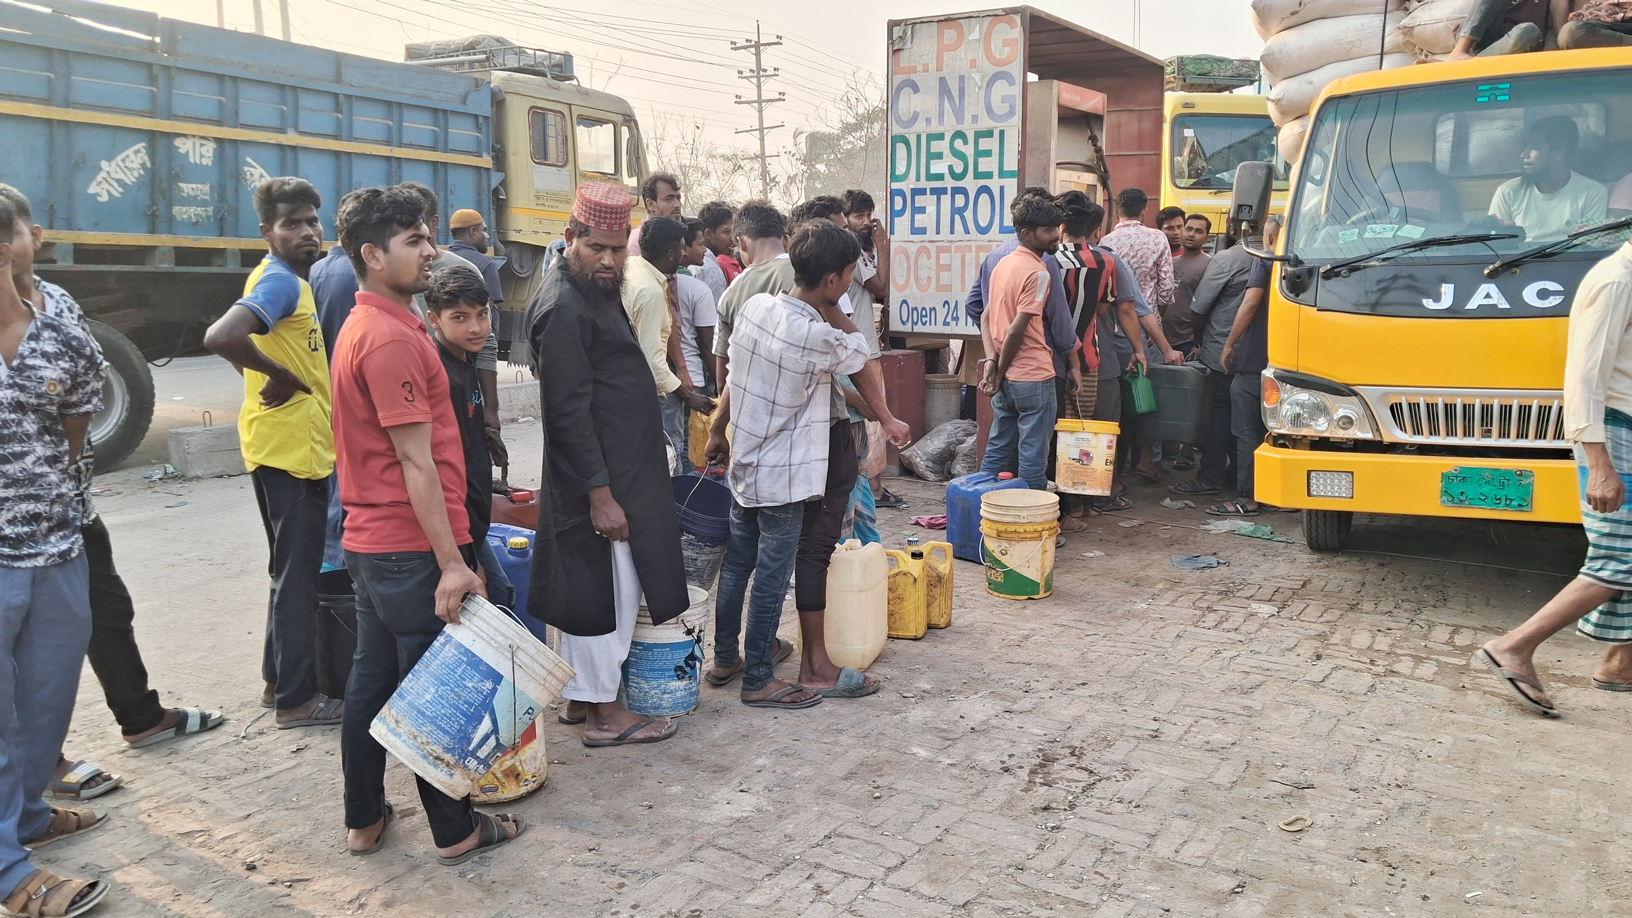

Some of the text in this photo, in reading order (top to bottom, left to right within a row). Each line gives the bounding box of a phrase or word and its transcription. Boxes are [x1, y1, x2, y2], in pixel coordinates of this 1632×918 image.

[891, 70, 1017, 129] C.N.G
[891, 129, 1018, 183] DIESEL
[890, 185, 1016, 235] PETROL
[891, 245, 1004, 293] OCET
[899, 299, 937, 331] Open
[942, 300, 960, 327] 24
[1422, 281, 1565, 310] JAC
[401, 381, 415, 402] 3
